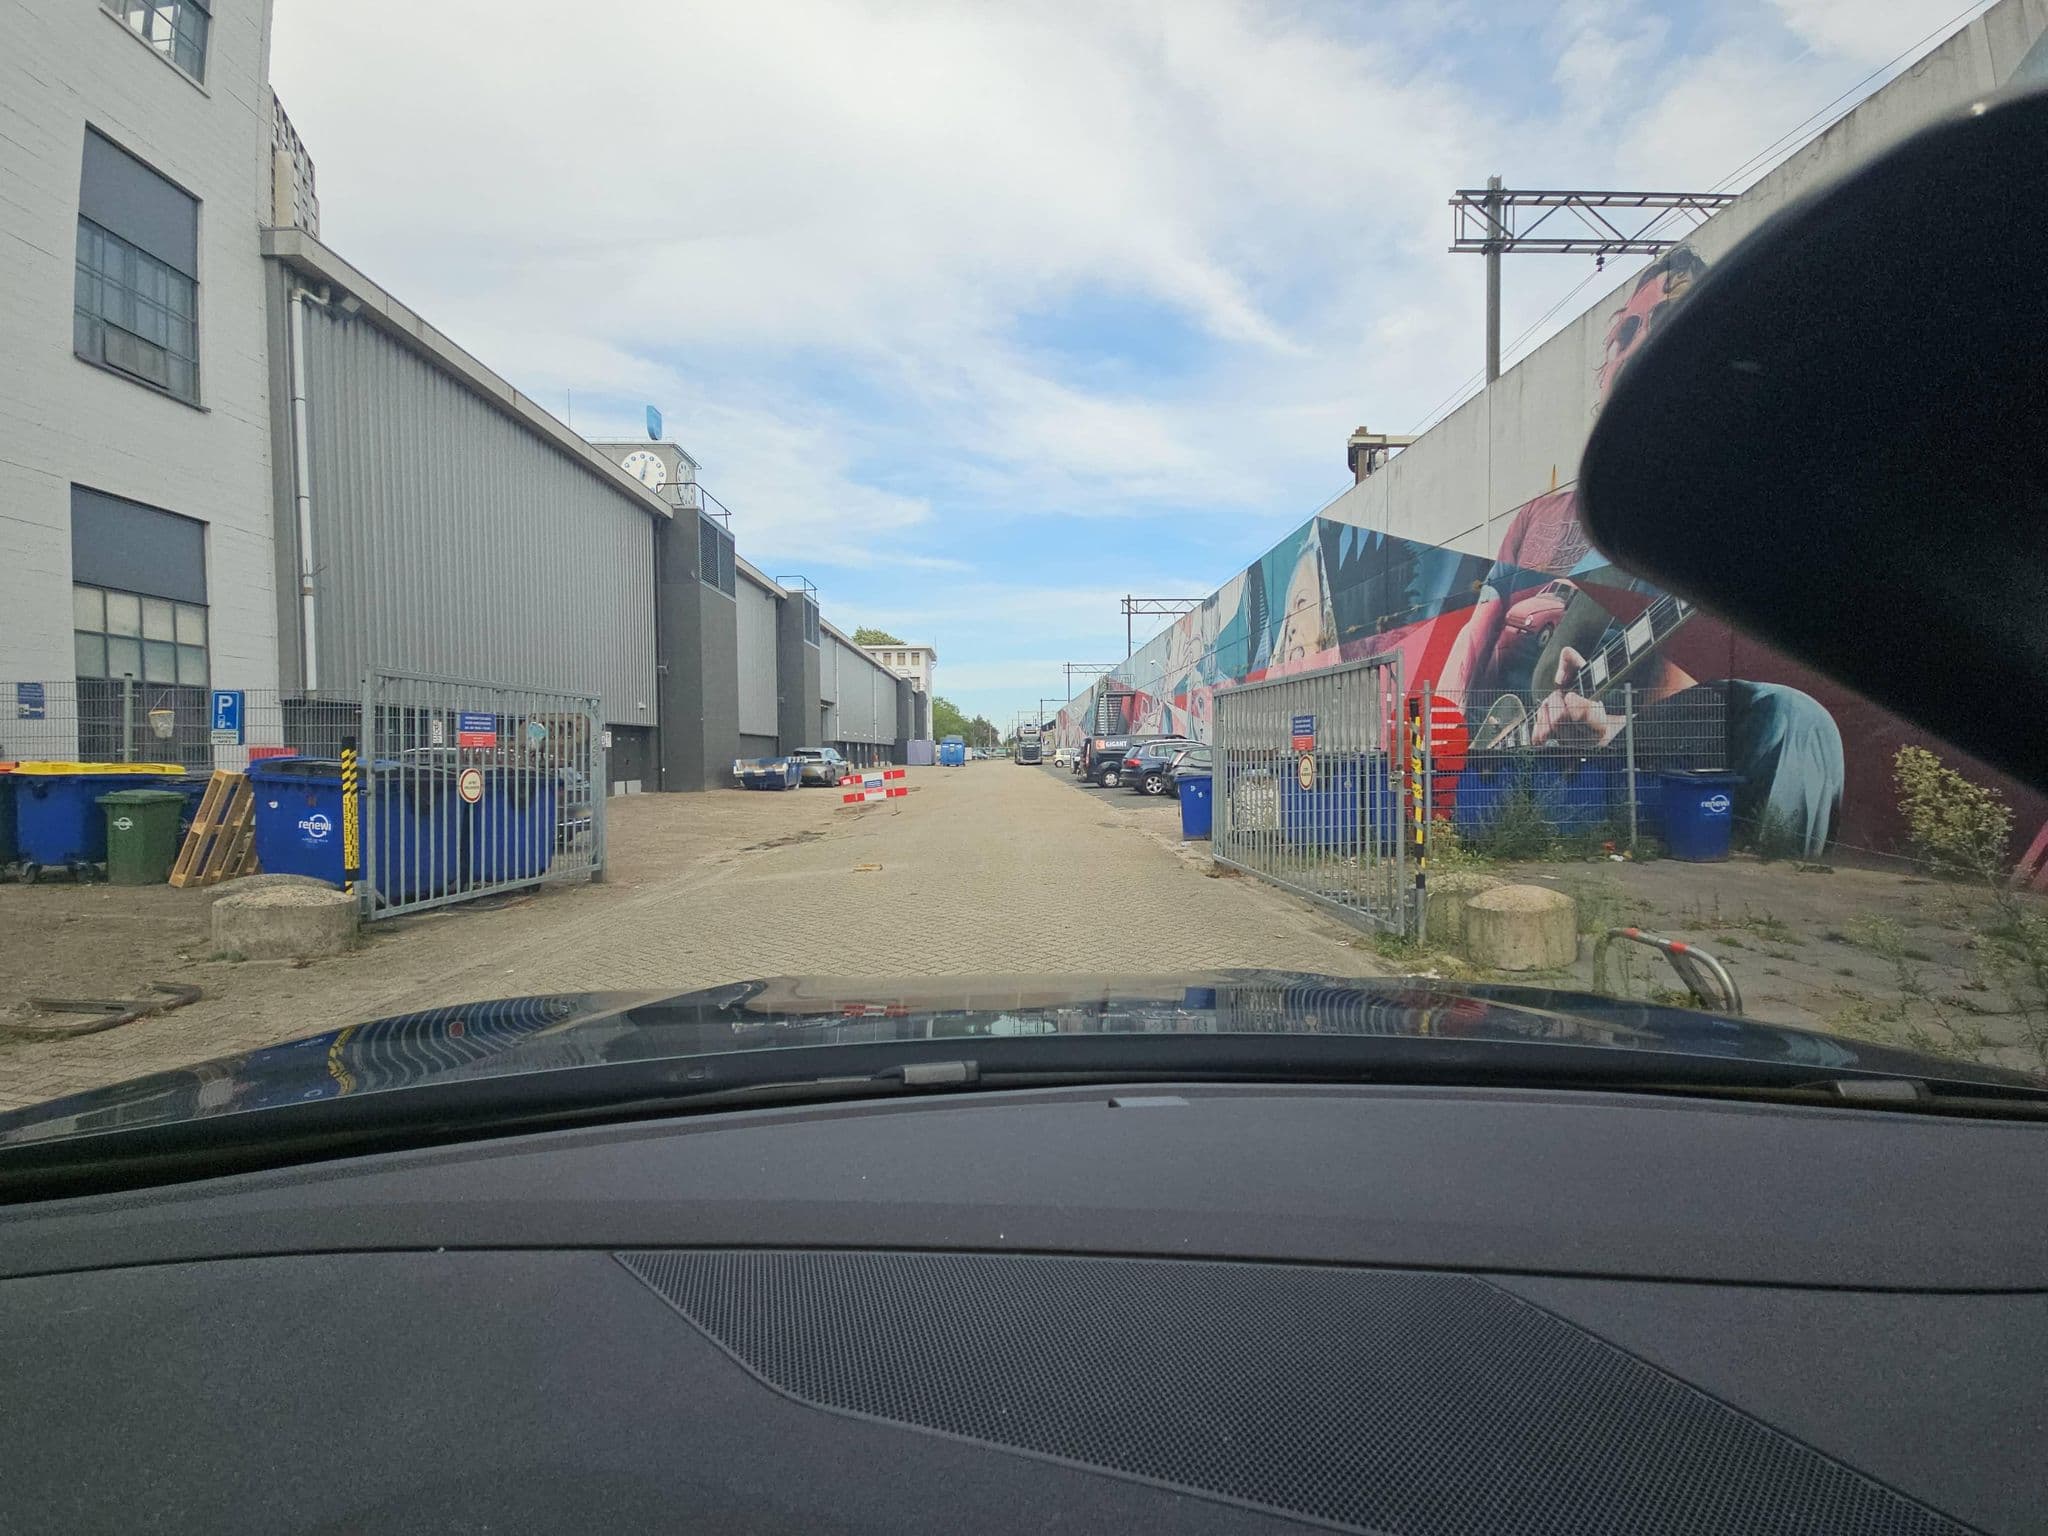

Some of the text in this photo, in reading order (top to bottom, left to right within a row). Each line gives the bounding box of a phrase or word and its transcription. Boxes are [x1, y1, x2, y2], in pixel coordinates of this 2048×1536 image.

[218, 695, 233, 715] P
[1105, 740, 1128, 748] GIGANT
[298, 819, 332, 832] renewi
